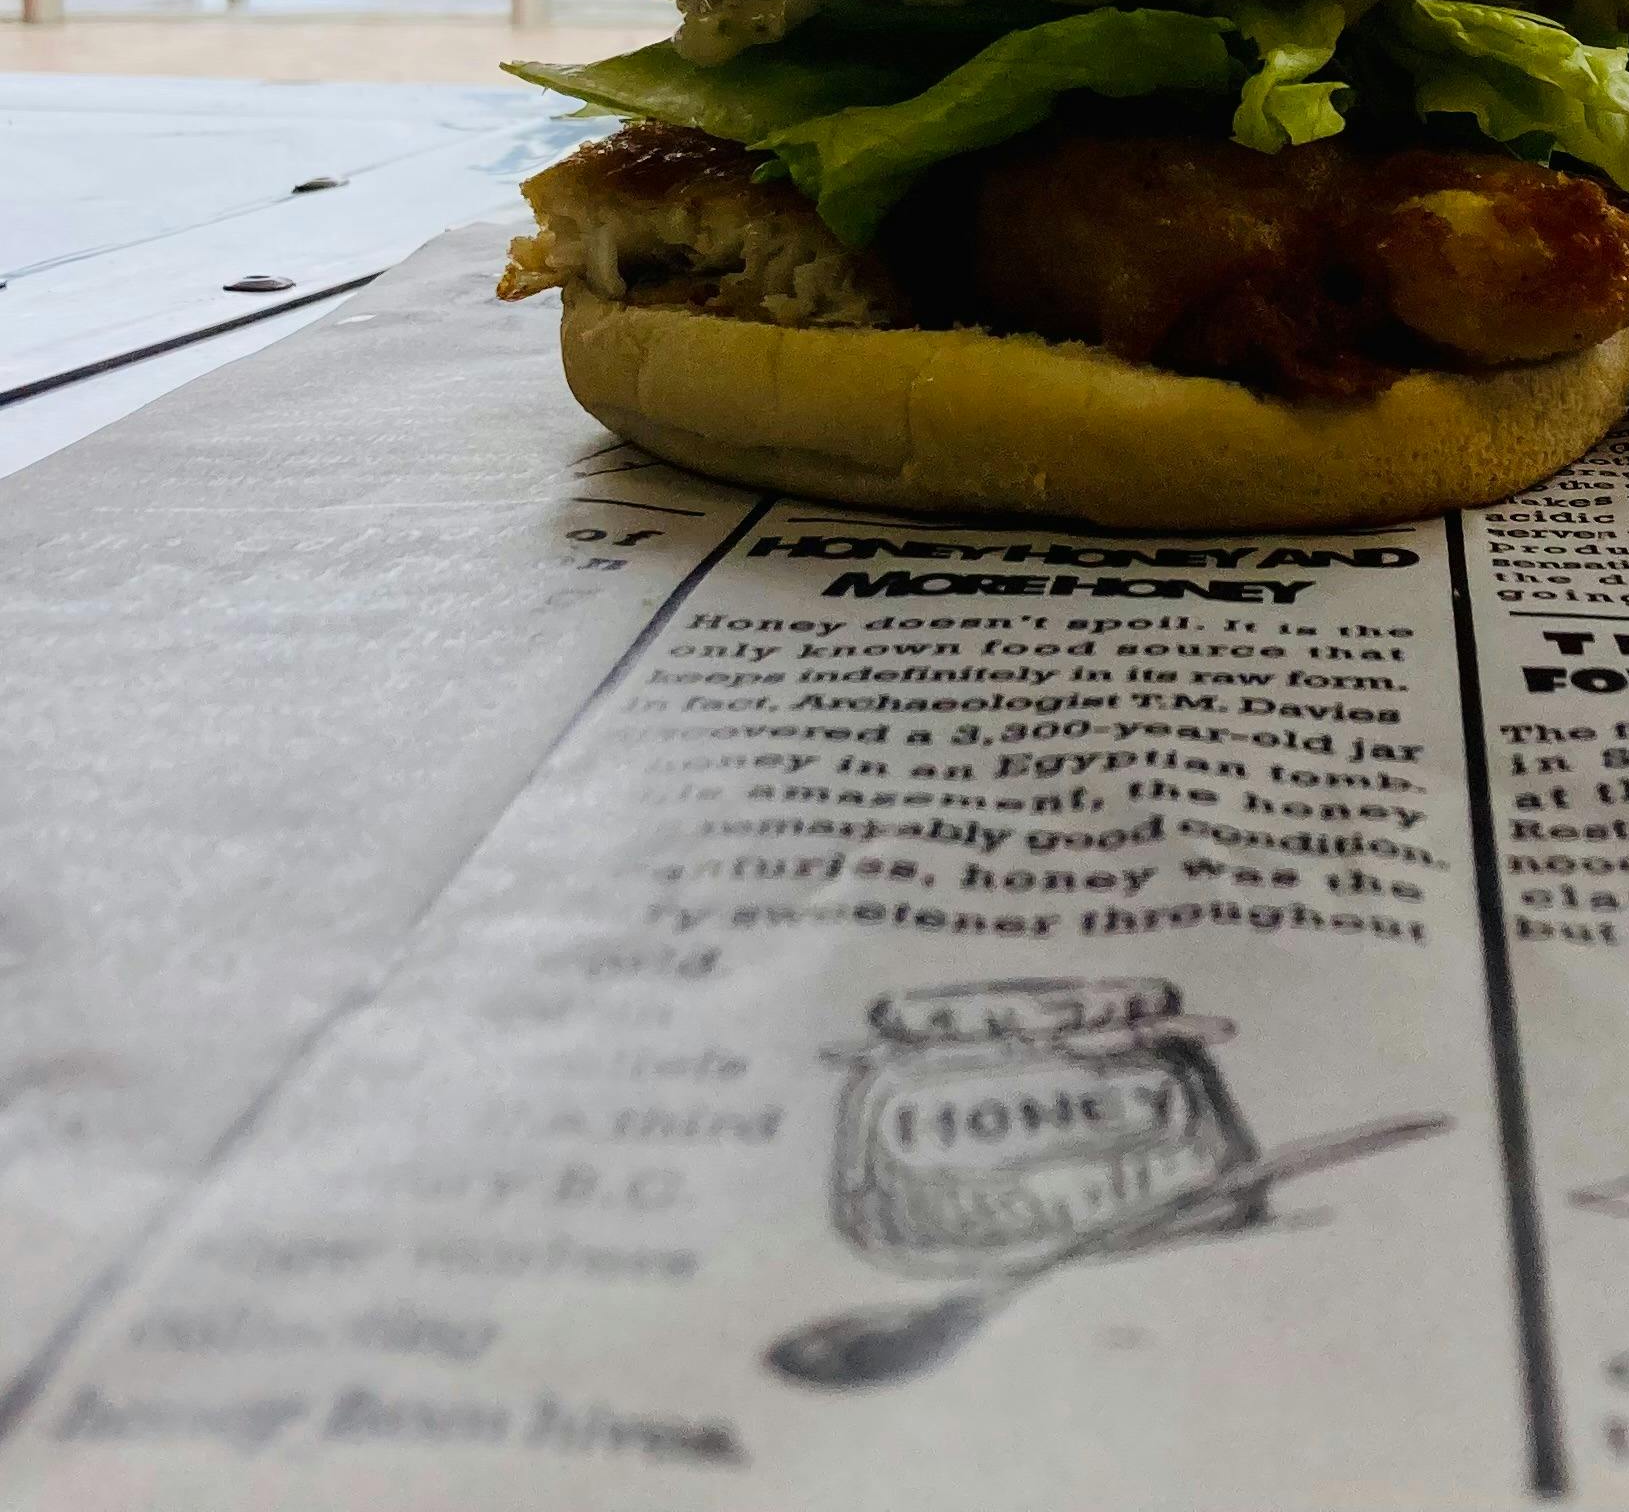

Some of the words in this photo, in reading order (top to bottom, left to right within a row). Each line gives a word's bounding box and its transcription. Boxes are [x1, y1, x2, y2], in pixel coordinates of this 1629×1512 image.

[1557, 478, 1615, 490] the
[1484, 507, 1616, 524] acidic
[1486, 525, 1619, 540] serves
[1255, 546, 1421, 570] AND
[819, 570, 1051, 598] MORE
[1048, 575, 1317, 606] HONEY
[1492, 570, 1573, 586] the
[683, 613, 848, 637] Honey
[864, 612, 1049, 634] doesn't
[1065, 614, 1206, 636] spoil.
[1222, 618, 1258, 635] It
[1278, 620, 1318, 637] is
[1336, 622, 1416, 640] the
[667, 641, 783, 662] only
[797, 641, 962, 660] known
[978, 638, 1097, 659] food
[1115, 642, 1287, 659] source
[1308, 644, 1407, 663] that
[797, 663, 1061, 686] indefinitely
[1069, 666, 1113, 684] in
[1125, 665, 1180, 684] its
[1189, 669, 1276, 685] raw
[1285, 668, 1410, 692] form.
[788, 689, 1120, 715] Archaeologist
[1236, 695, 1402, 725] Davies
[1499, 721, 1599, 746] The
[835, 753, 889, 777] in
[907, 762, 977, 782] an
[992, 747, 1251, 780] Egyptian
[1346, 736, 1425, 766] jar
[1510, 751, 1573, 777] in
[1126, 777, 1222, 807] the
[1241, 789, 1430, 830] honey
[1514, 783, 1573, 813] at
[1025, 811, 1166, 855] good
[958, 859, 1161, 898] honey
[1179, 856, 1303, 890] was
[1323, 866, 1426, 903] the
